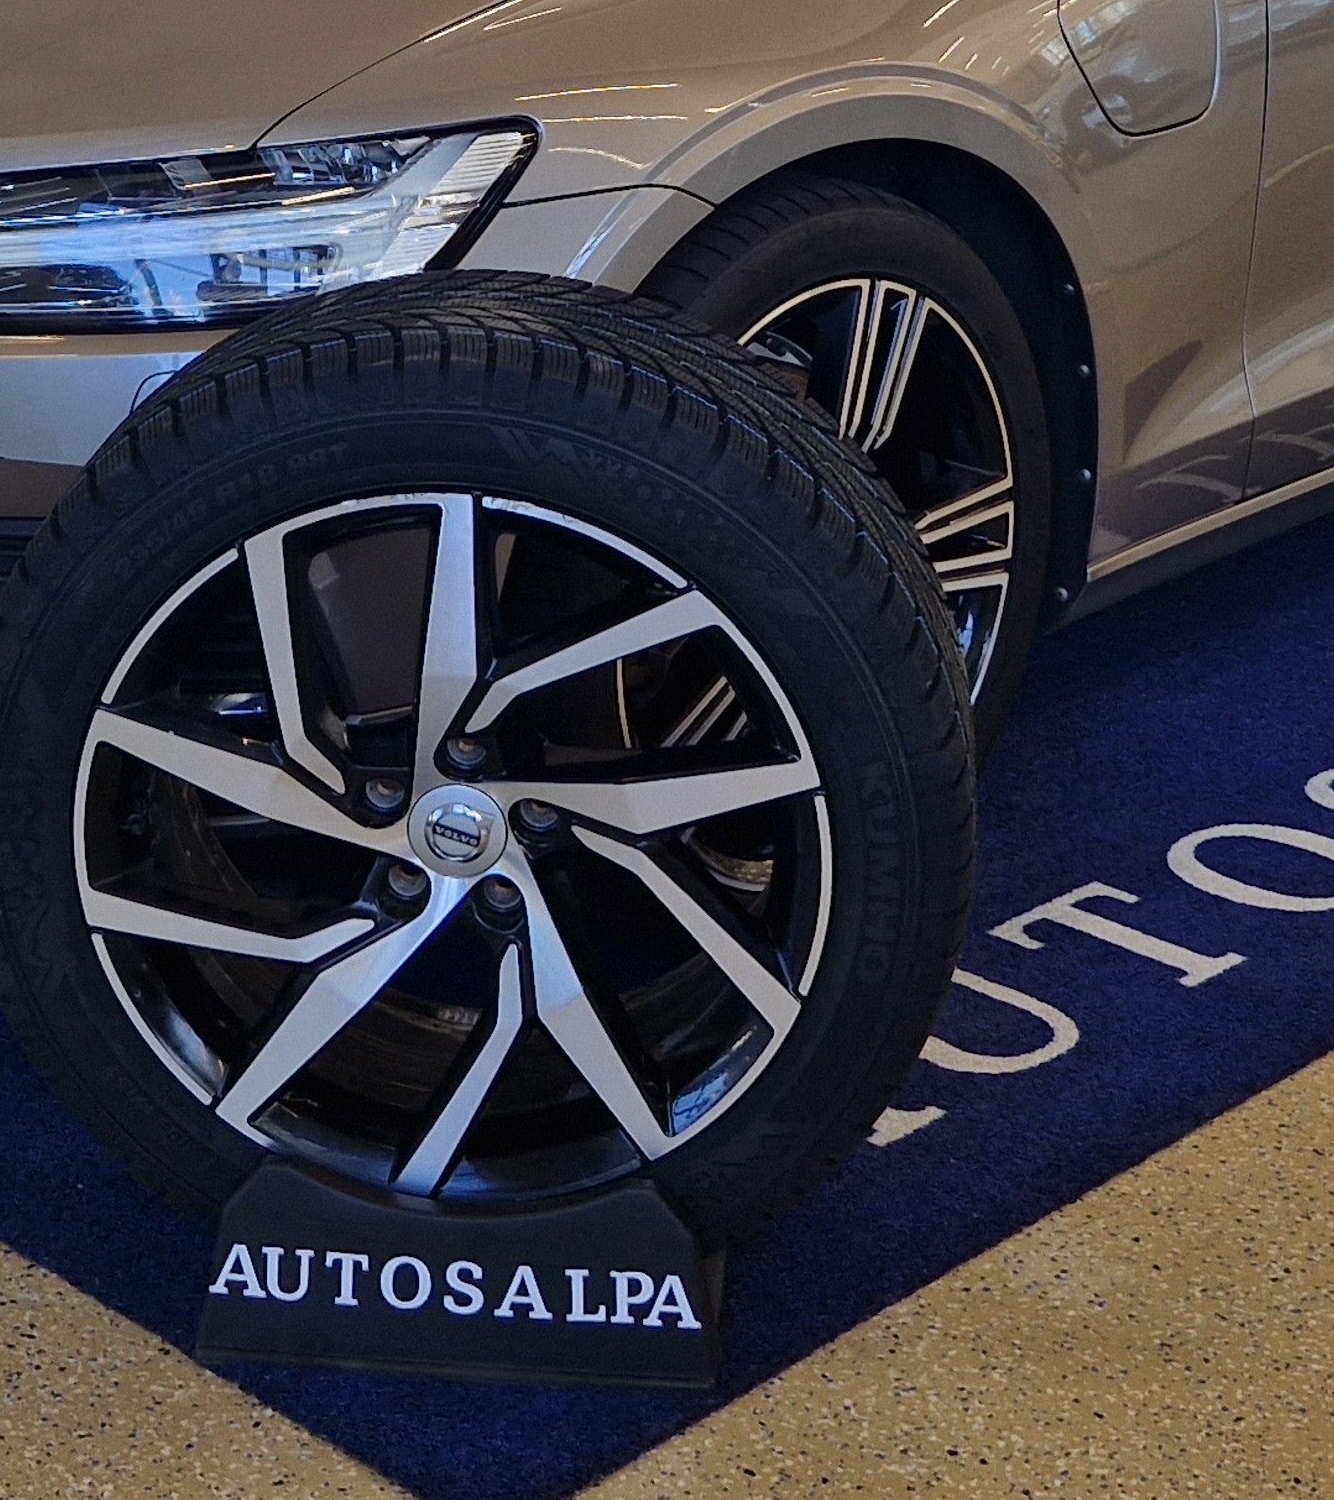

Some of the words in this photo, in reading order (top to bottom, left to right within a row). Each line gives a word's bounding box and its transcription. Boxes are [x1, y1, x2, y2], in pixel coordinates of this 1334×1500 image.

[433, 824, 479, 846] VOLVO
[854, 759, 903, 986] KUMHO
[208, 1242, 703, 1330] AUTOSALPA
